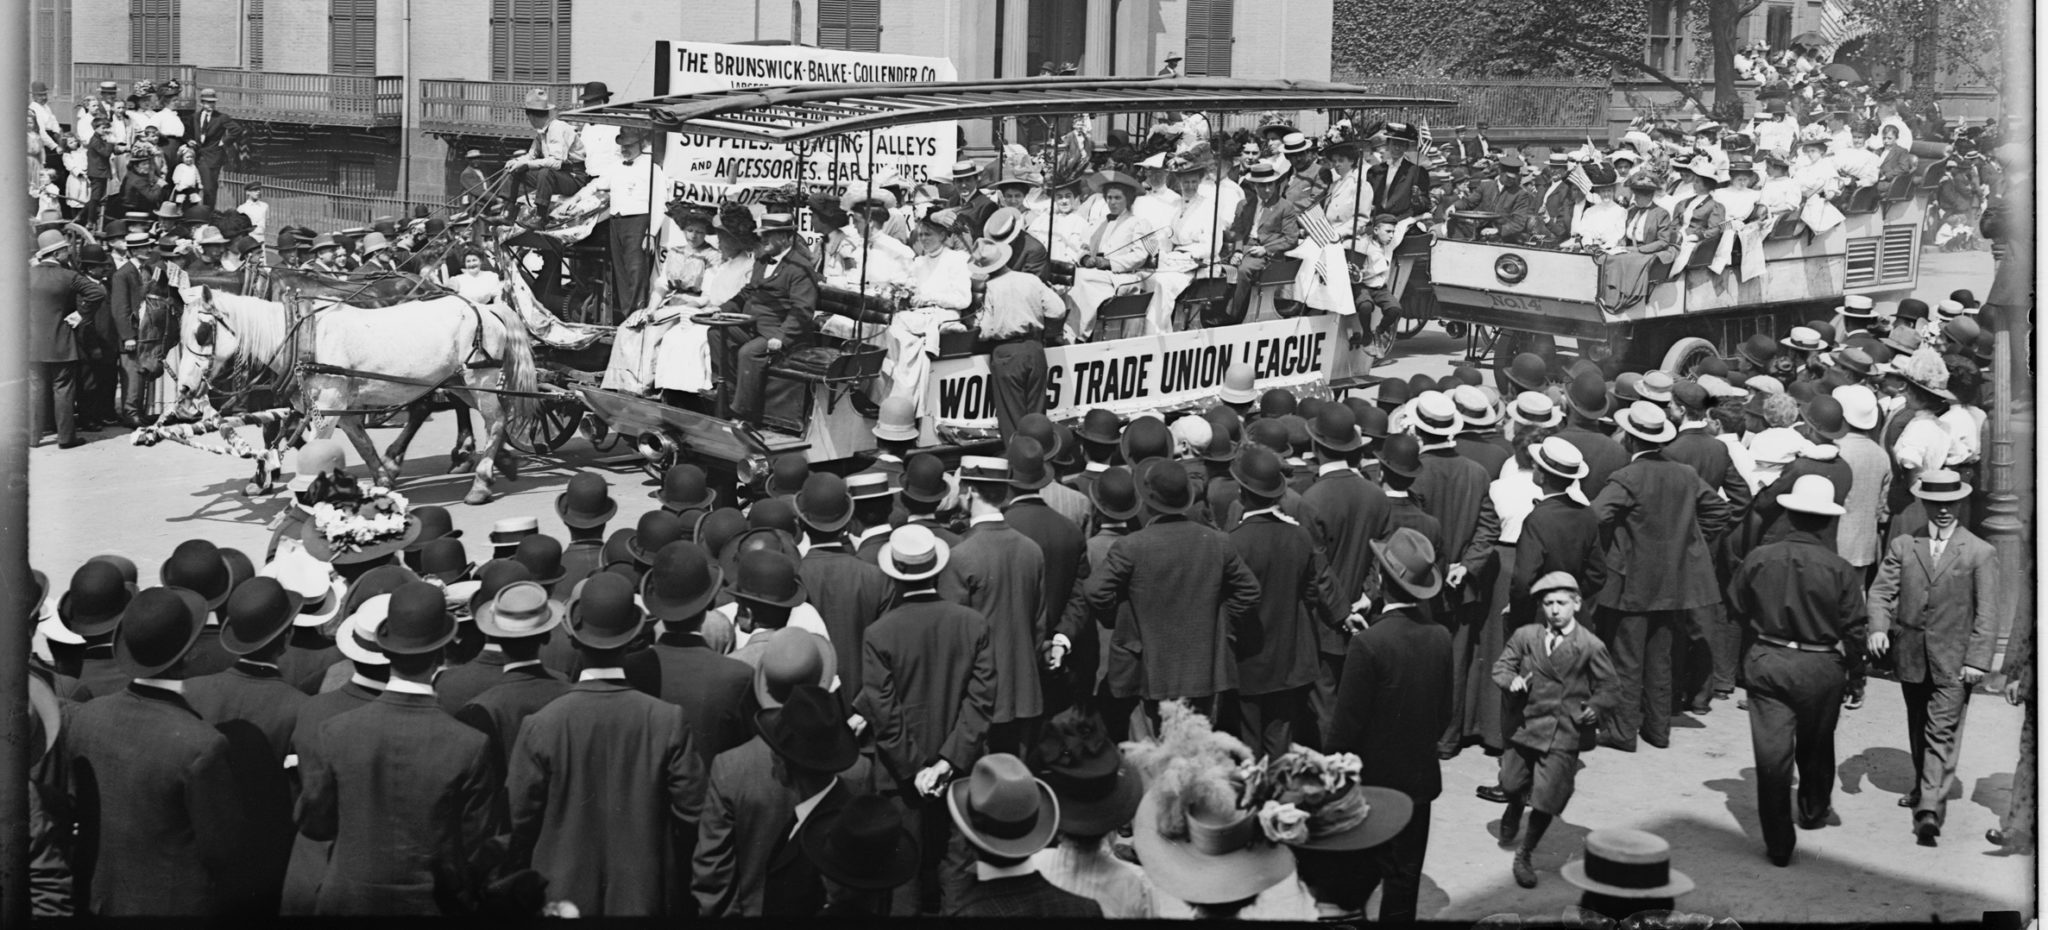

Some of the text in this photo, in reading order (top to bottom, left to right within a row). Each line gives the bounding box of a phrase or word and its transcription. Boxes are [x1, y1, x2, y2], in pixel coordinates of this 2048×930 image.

[677, 48, 708, 73] THE
[785, 133, 863, 153] WLNG
[876, 135, 936, 156] ALLEYS
[690, 160, 712, 171] AND
[673, 181, 729, 203] BANK
[940, 365, 1063, 419] WOMS
[1074, 354, 1153, 406] TRADE
[1160, 343, 1233, 394] UNION
